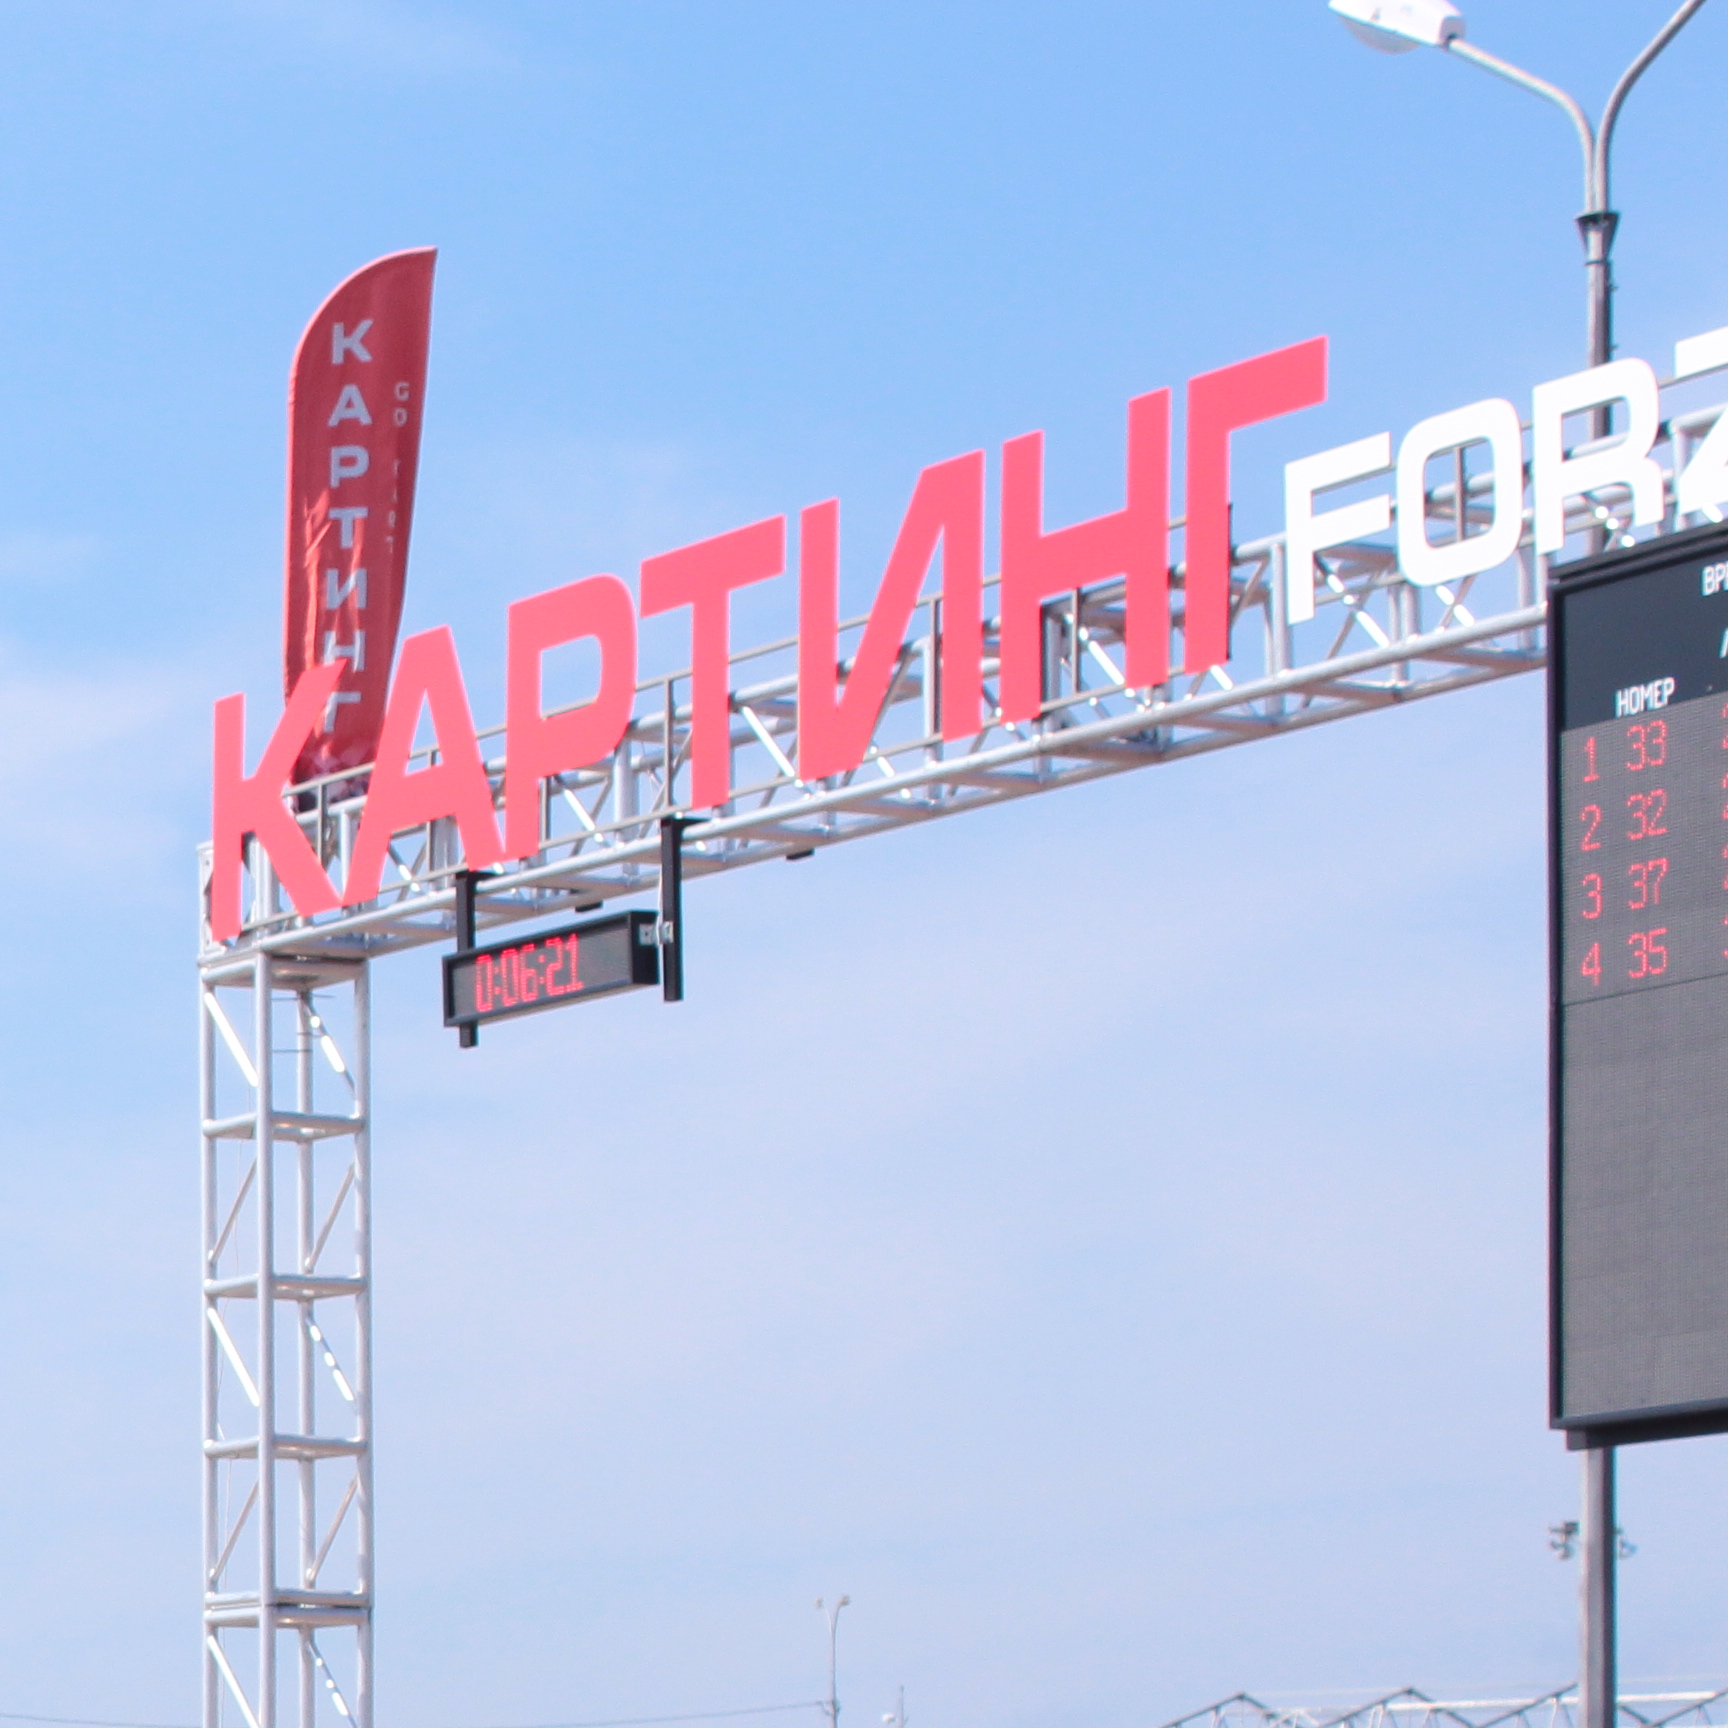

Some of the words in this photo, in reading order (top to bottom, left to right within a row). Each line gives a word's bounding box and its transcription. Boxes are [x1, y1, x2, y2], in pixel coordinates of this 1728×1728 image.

[322, 318, 374, 733] КАРТИНГ
[211, 334, 1328, 942] КАРТИНГ
[1615, 677, 1676, 718] НОМЕР
[1583, 736, 1601, 783] 1
[1626, 719, 1668, 771] 33
[1580, 804, 1602, 851] 2
[1626, 788, 1669, 840] 32
[1581, 873, 1602, 920] 3
[1627, 857, 1669, 910] 37
[475, 932, 585, 1013] 0:06:21
[1580, 941, 1602, 987] 4
[1627, 927, 1668, 979] 35
